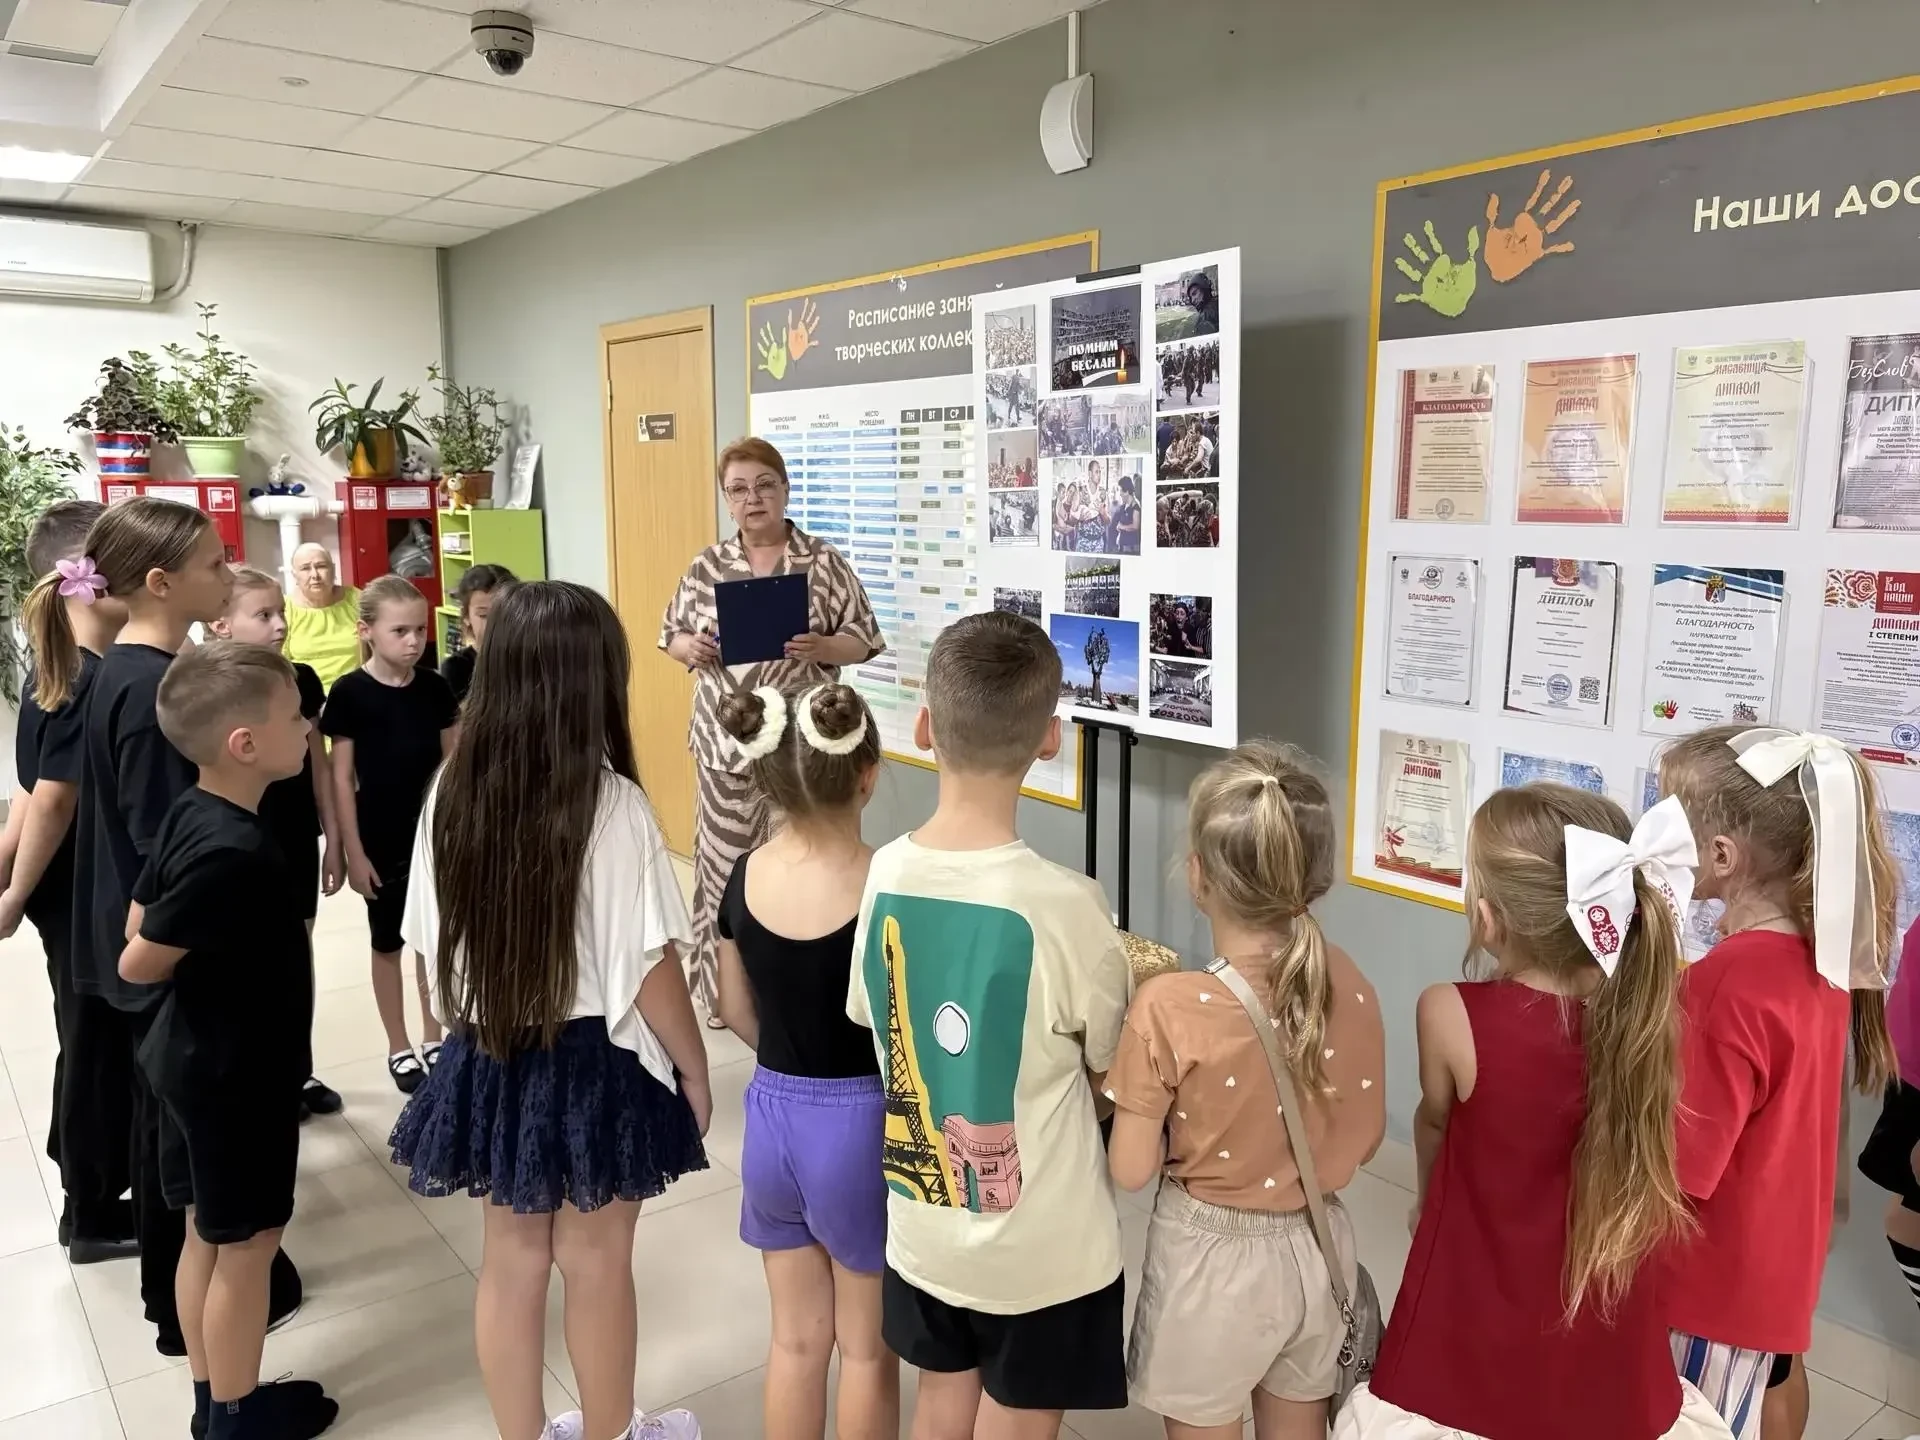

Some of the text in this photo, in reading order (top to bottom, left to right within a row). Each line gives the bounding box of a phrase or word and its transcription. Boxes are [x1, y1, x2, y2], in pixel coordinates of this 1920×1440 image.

[1693, 189, 1821, 233] Наши
[848, 300, 936, 329] Расписание
[834, 329, 973, 364] творческих коллек
[1068, 340, 1118, 356] ПОМНИМ
[1071, 356, 1116, 372] БЕСЛАН
[1715, 381, 1760, 397] ДИПЛОМ
[1422, 402, 1486, 411] БЛАГОДАРНОСТЬ
[906, 408, 960, 421] ПН ВТ СР
[1884, 576, 1906, 592] Код
[1408, 592, 1456, 603] БЛАГОДАРНОСТЬ
[1537, 594, 1595, 608] ДИПЛОМ
[1675, 617, 1755, 631] БЛАГОДАРНОСТЬ
[1872, 617, 1920, 631] ДИПЛОМ
[1689, 632, 1738, 641] НАГРАЖДАЕТСЯ
[1876, 632, 1919, 642] СТЕПЕНИ
[1403, 763, 1442, 780] ДИПЛОМ
